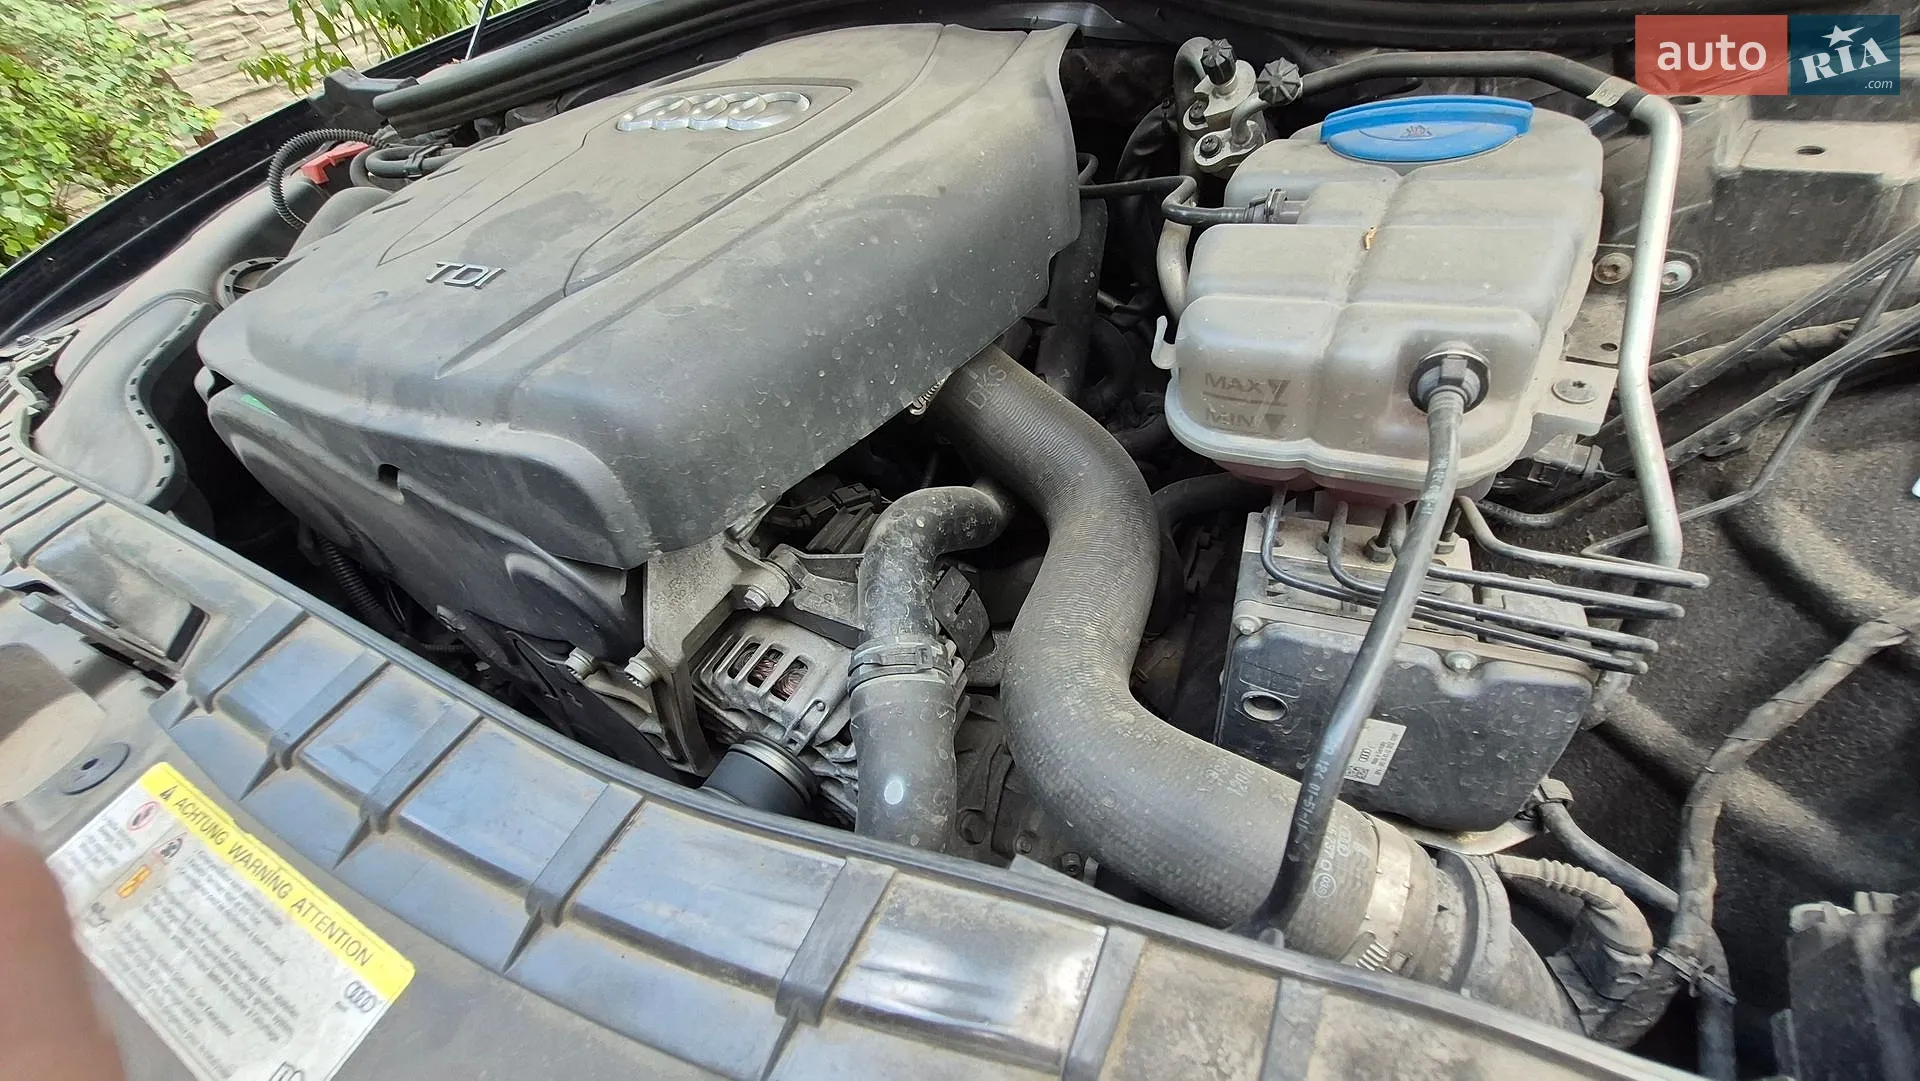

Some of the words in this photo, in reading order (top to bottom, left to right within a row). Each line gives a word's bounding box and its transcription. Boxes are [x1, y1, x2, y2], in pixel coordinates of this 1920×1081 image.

[425, 261, 506, 289] TDI
[1205, 372, 1263, 394] MAX
[1205, 407, 1255, 426] MIN
[174, 796, 227, 845] ACHTUNG
[227, 840, 294, 899] WARNING
[292, 892, 374, 967] ATTENTION
